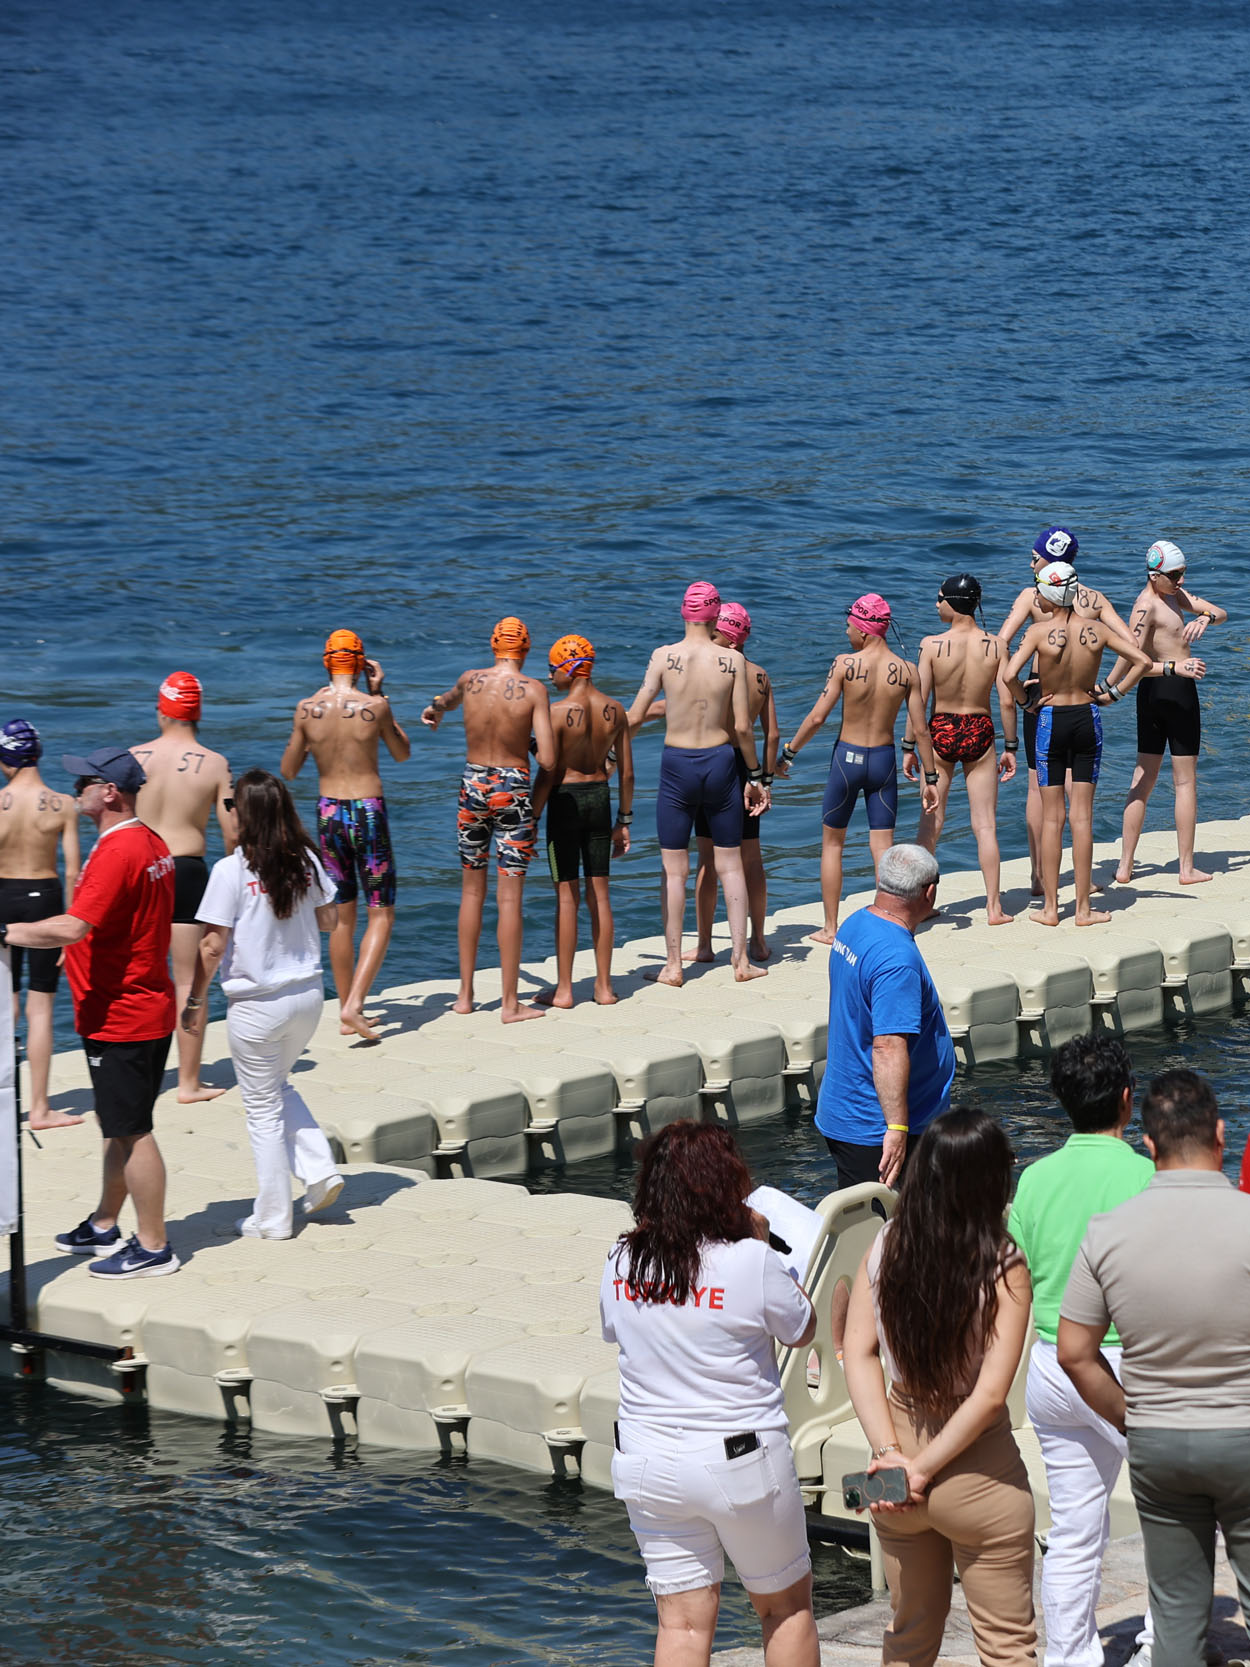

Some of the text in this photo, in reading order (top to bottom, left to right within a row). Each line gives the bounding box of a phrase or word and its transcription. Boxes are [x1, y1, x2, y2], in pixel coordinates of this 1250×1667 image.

[1079, 589, 1103, 610] 82
[1048, 628, 1067, 648] 65
[1079, 627, 1098, 645] 65
[932, 640, 951, 658] 71
[982, 639, 998, 659] 71
[666, 653, 737, 676] 54 54
[843, 657, 909, 689] 84 84
[466, 673, 528, 700] 85 85
[566, 704, 617, 728] 67 67
[178, 752, 205, 774] 57
